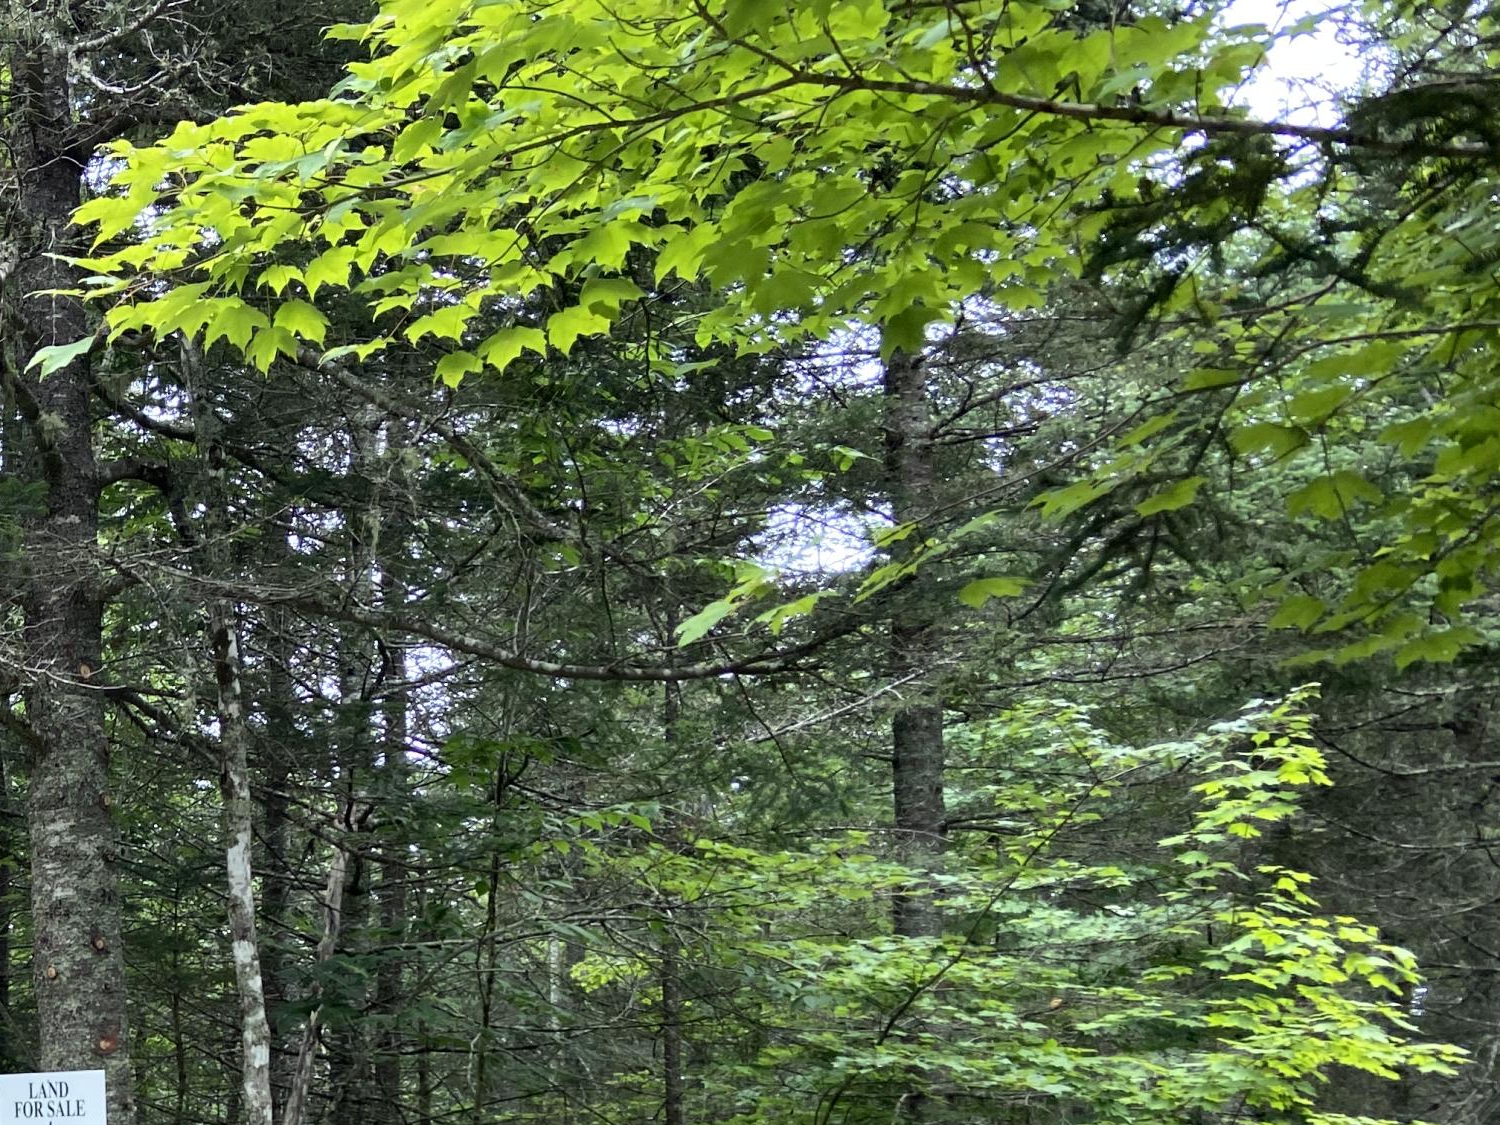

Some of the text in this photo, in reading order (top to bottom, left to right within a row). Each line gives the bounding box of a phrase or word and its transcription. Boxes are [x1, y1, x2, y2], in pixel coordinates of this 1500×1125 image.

[29, 1080, 69, 1099] LAND
[14, 1099, 86, 1118] FOR SALE
